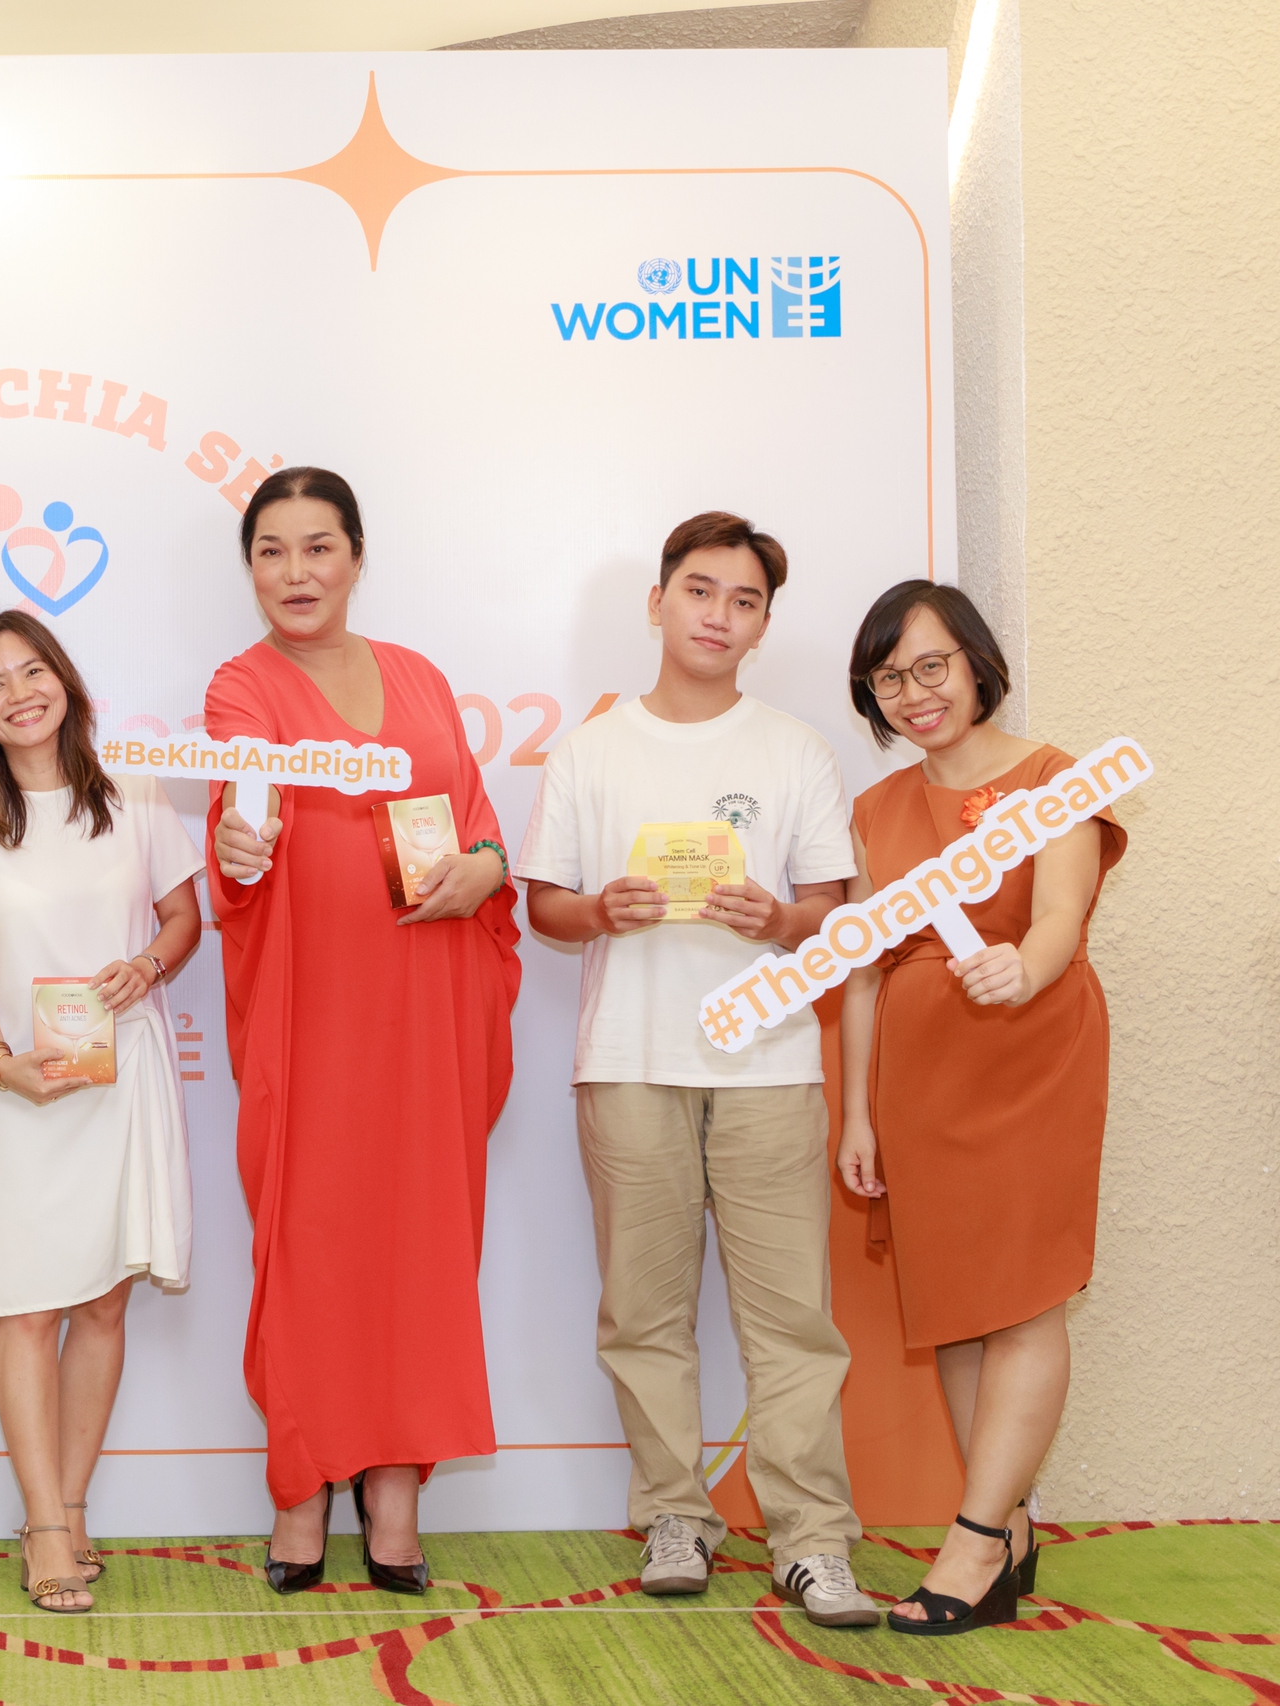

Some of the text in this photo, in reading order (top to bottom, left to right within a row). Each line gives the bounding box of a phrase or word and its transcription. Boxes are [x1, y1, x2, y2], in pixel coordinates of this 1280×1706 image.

[686, 257, 759, 296] UN
[550, 301, 760, 341] WOMEN
[101, 740, 401, 783] #BeKindAndRight
[715, 793, 758, 806] PARADISE
[412, 816, 436, 828] RETINOL
[702, 745, 1148, 1047] #TheOrangeTeam
[57, 1004, 89, 1014] RETINOL
